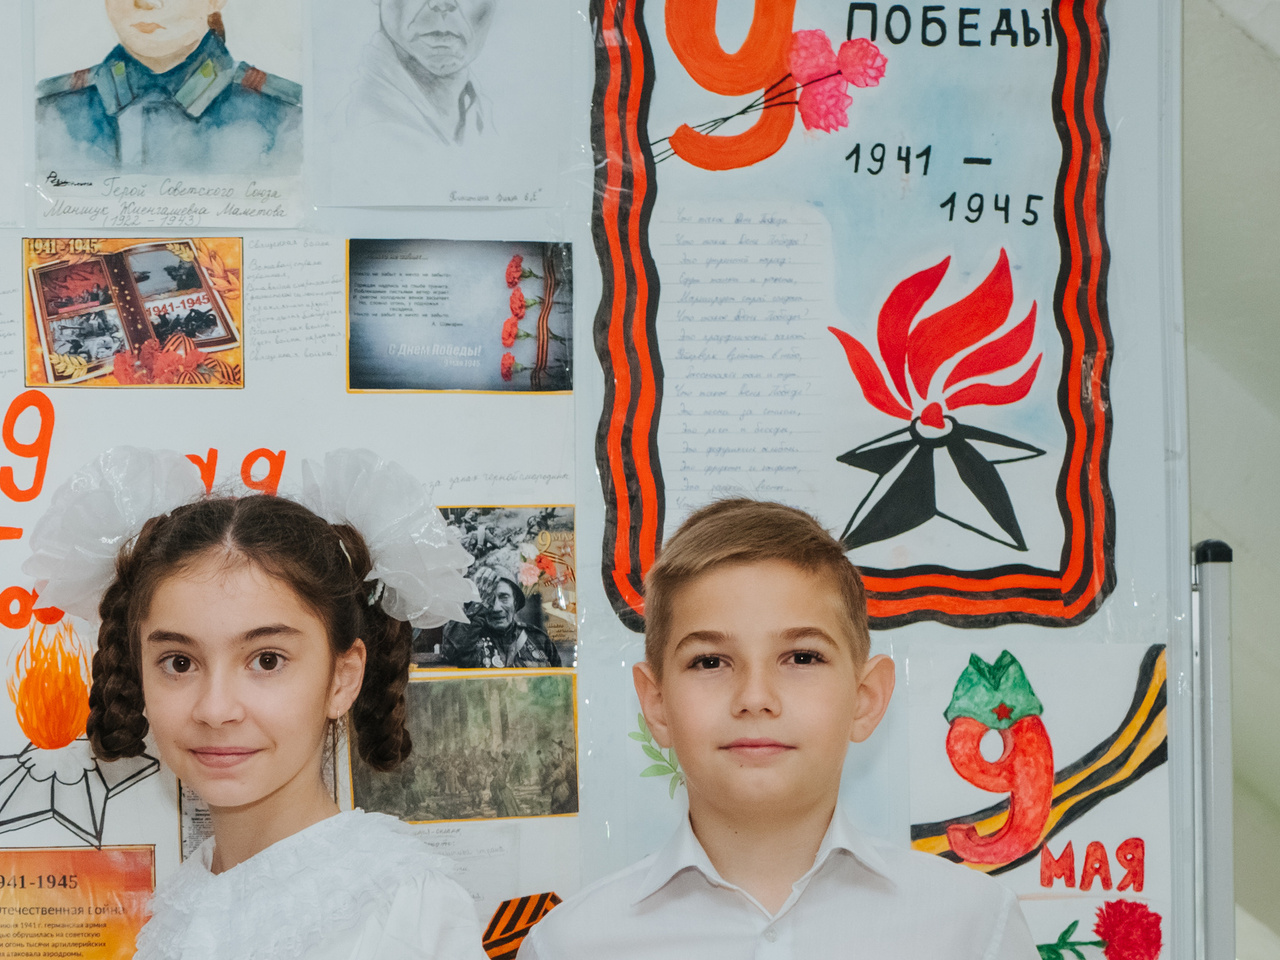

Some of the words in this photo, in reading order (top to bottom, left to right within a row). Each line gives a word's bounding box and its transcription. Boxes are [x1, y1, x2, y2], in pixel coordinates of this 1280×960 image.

[847, 2, 1052, 48] ПОБЕДЫ
[845, 143, 932, 175] 1941
[101, 176, 147, 202] Герой
[159, 178, 235, 199] Советского
[244, 181, 282, 202] Союза
[940, 193, 1044, 226] 1945
[69, 239, 99, 254] 1945
[145, 294, 211, 317] 1941-1945
[0, 389, 55, 502] 9
[945, 715, 1054, 865] 9
[1040, 837, 1145, 892] МАЯ
